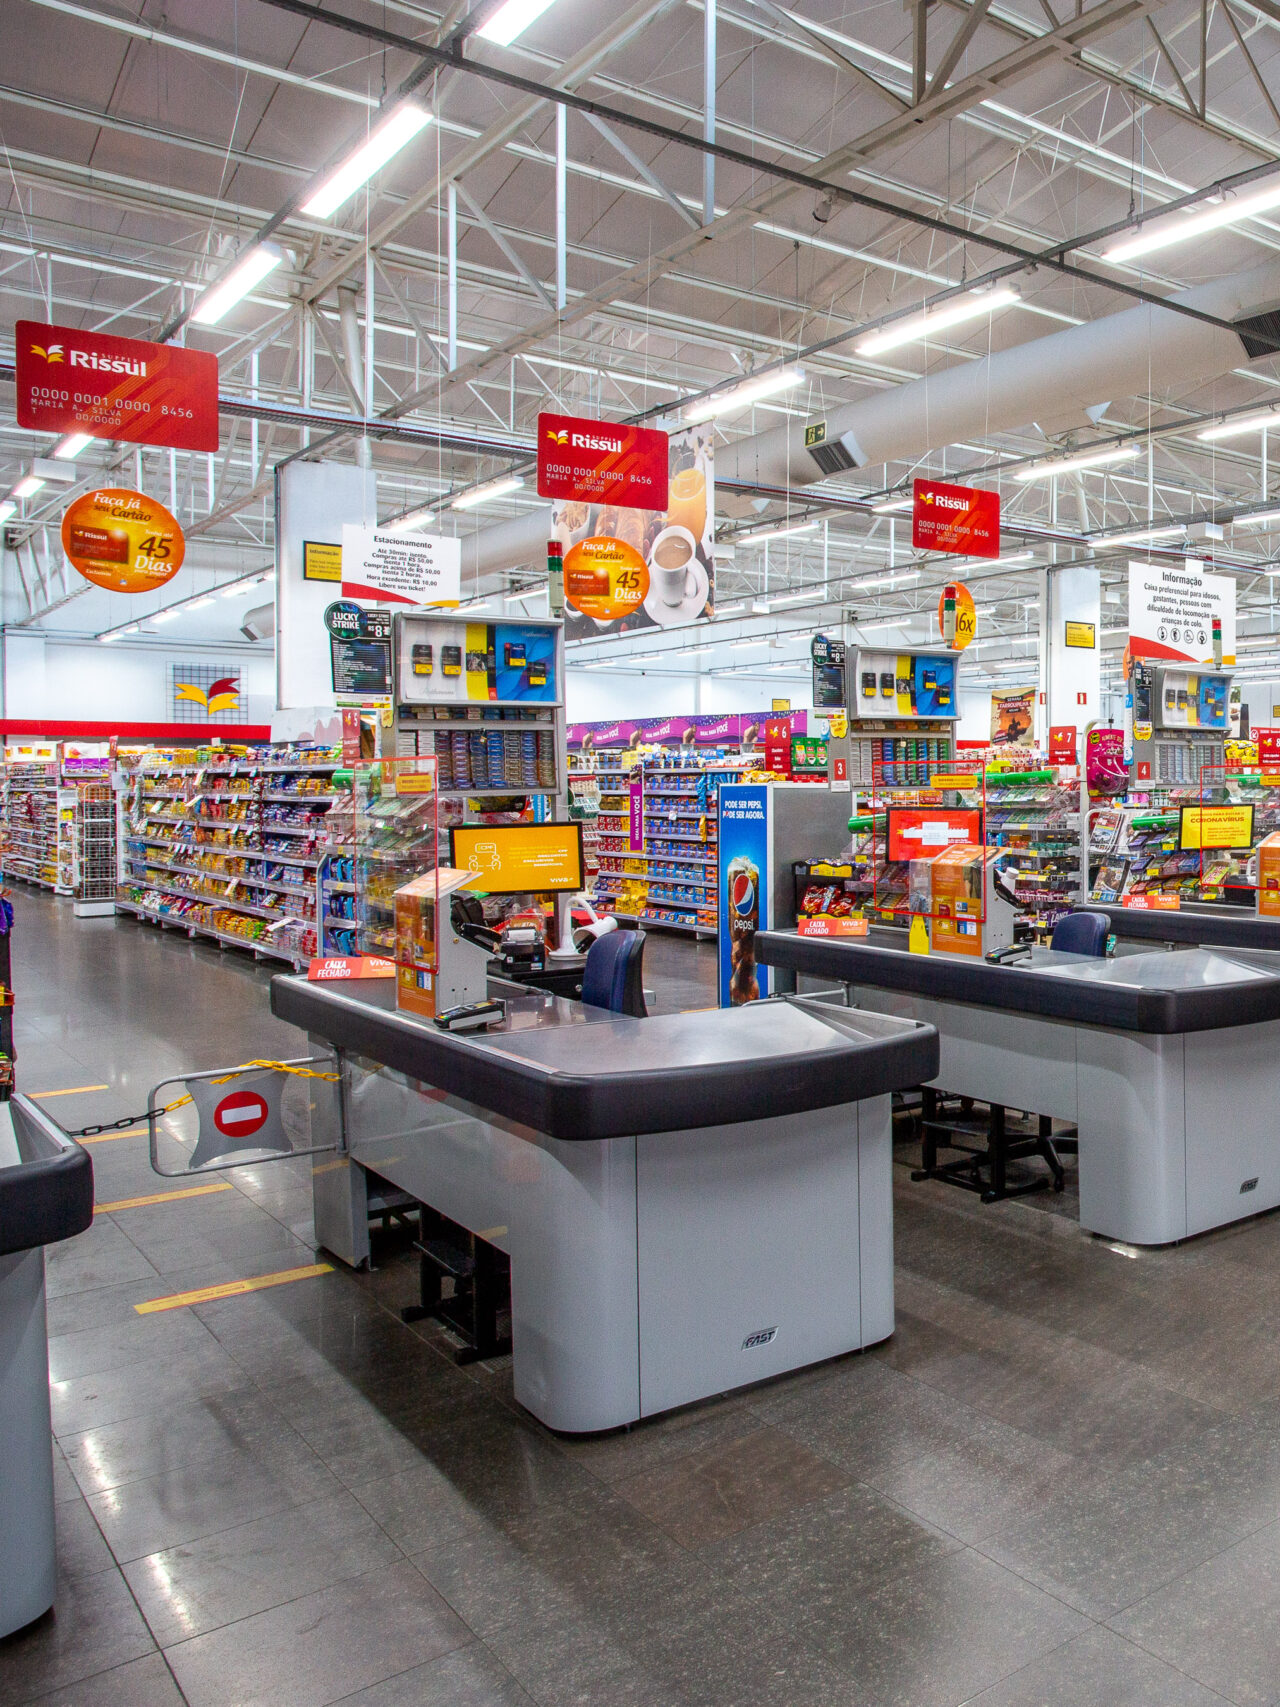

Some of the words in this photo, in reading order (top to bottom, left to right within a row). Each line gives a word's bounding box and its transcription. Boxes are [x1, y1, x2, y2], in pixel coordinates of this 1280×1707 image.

[70, 350, 146, 377] Rissul
[31, 386, 69, 400] 0000
[74, 393, 109, 406] 0001
[115, 398, 150, 412] 0000
[161, 405, 193, 418] 8456
[31, 398, 64, 409] MARIA
[92, 408, 122, 417] SILVA
[572, 434, 622, 453] Rissul
[546, 464, 570, 474] 0000
[574, 468, 596, 477] 0001
[600, 472, 624, 480] 0000
[630, 475, 652, 484] 8456
[94, 492, 124, 507] Faça
[124, 498, 141, 510] já
[936, 496, 968, 511] Rissul
[112, 506, 152, 522] Cartão
[138, 536, 173, 558] 45
[374, 536, 432, 549] Estacionamento
[582, 542, 604, 551] Faça
[604, 542, 616, 552] já
[372, 552, 397, 561] Compras
[596, 552, 624, 560] Cartão
[134, 555, 173, 573] Dias
[364, 562, 388, 570] Compras
[616, 572, 640, 588] 45
[1162, 572, 1202, 588] Informação
[614, 588, 642, 600] Dias
[1144, 583, 1158, 592] Caixa
[1159, 586, 1188, 596] preferencial
[1153, 595, 1178, 604] gestantes,
[334, 613, 359, 622] LUCKY
[1147, 604, 1174, 614] dificuldade
[1183, 609, 1210, 619] locomoção
[332, 621, 360, 630] STRIKE
[1162, 616, 1182, 626] crianças
[782, 728, 786, 738] 6
[1066, 732, 1072, 743] 7
[1276, 738, 1280, 748] 8
[838, 763, 843, 775] 3
[1142, 766, 1146, 776] 4
[736, 811, 744, 819] SER
[1190, 816, 1244, 824] CORONAVÍRUS
[325, 960, 346, 968] CAIXA
[317, 969, 351, 978] FECHADO
